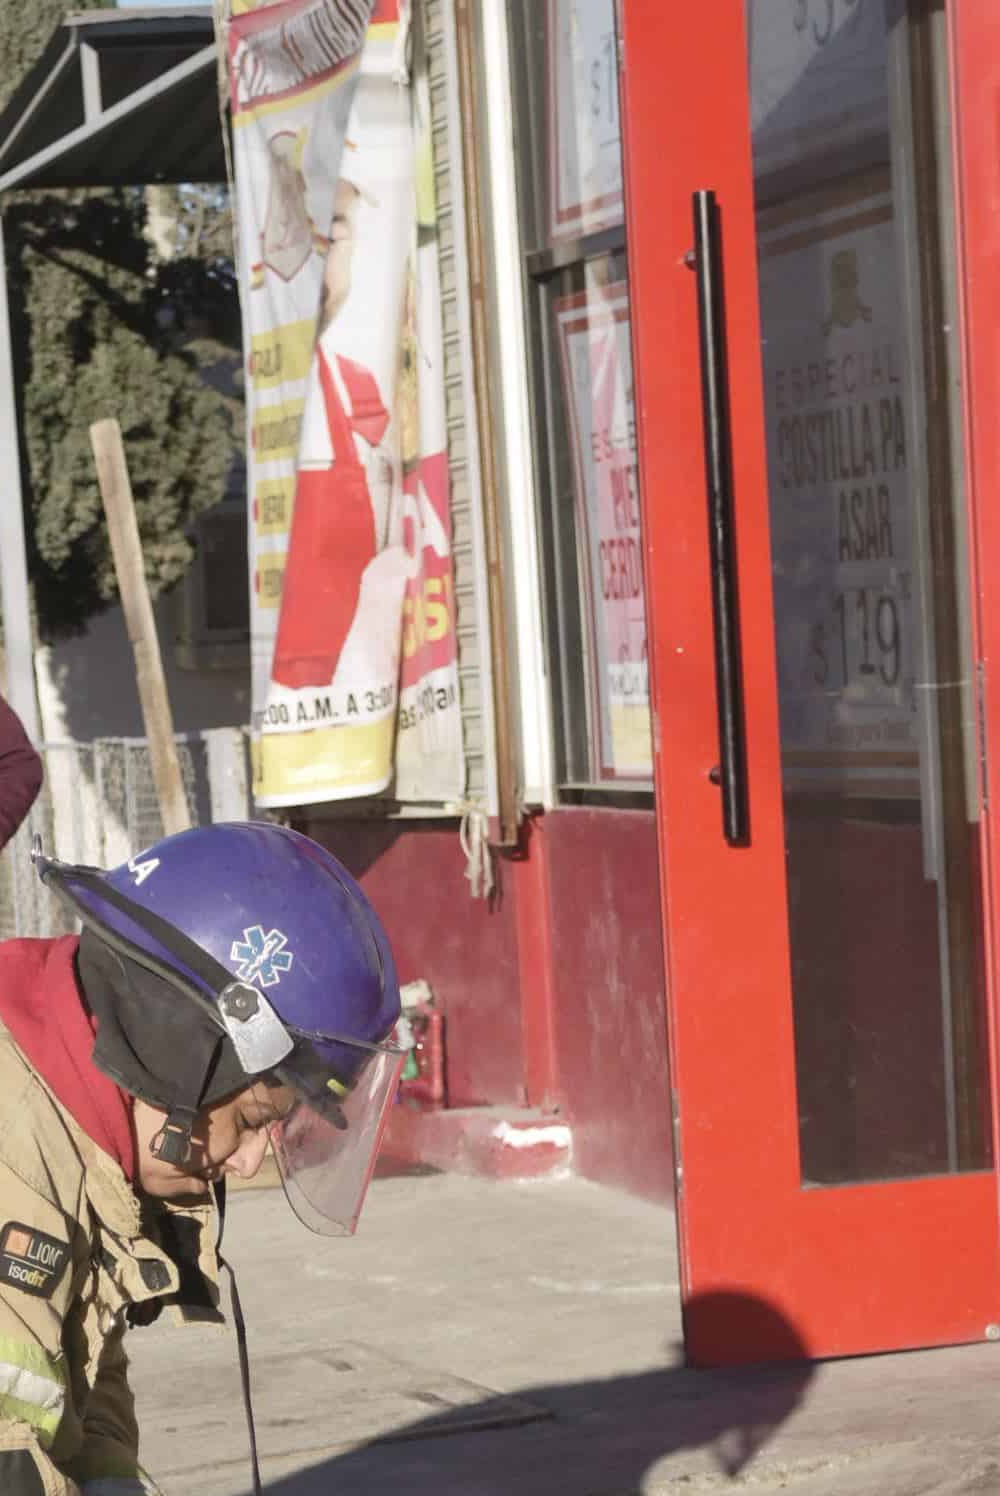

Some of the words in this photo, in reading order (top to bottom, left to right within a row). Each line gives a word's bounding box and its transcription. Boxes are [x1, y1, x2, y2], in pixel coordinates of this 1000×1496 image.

[775, 349, 902, 408] ESPECIAL
[775, 402, 875, 488] COSTILLA
[838, 483, 895, 562] ASAR
[297, 695, 339, 722] A.M.
[346, 693, 359, 715] A
[7, 1261, 48, 1289] isodri
[26, 1237, 61, 1268] LION
